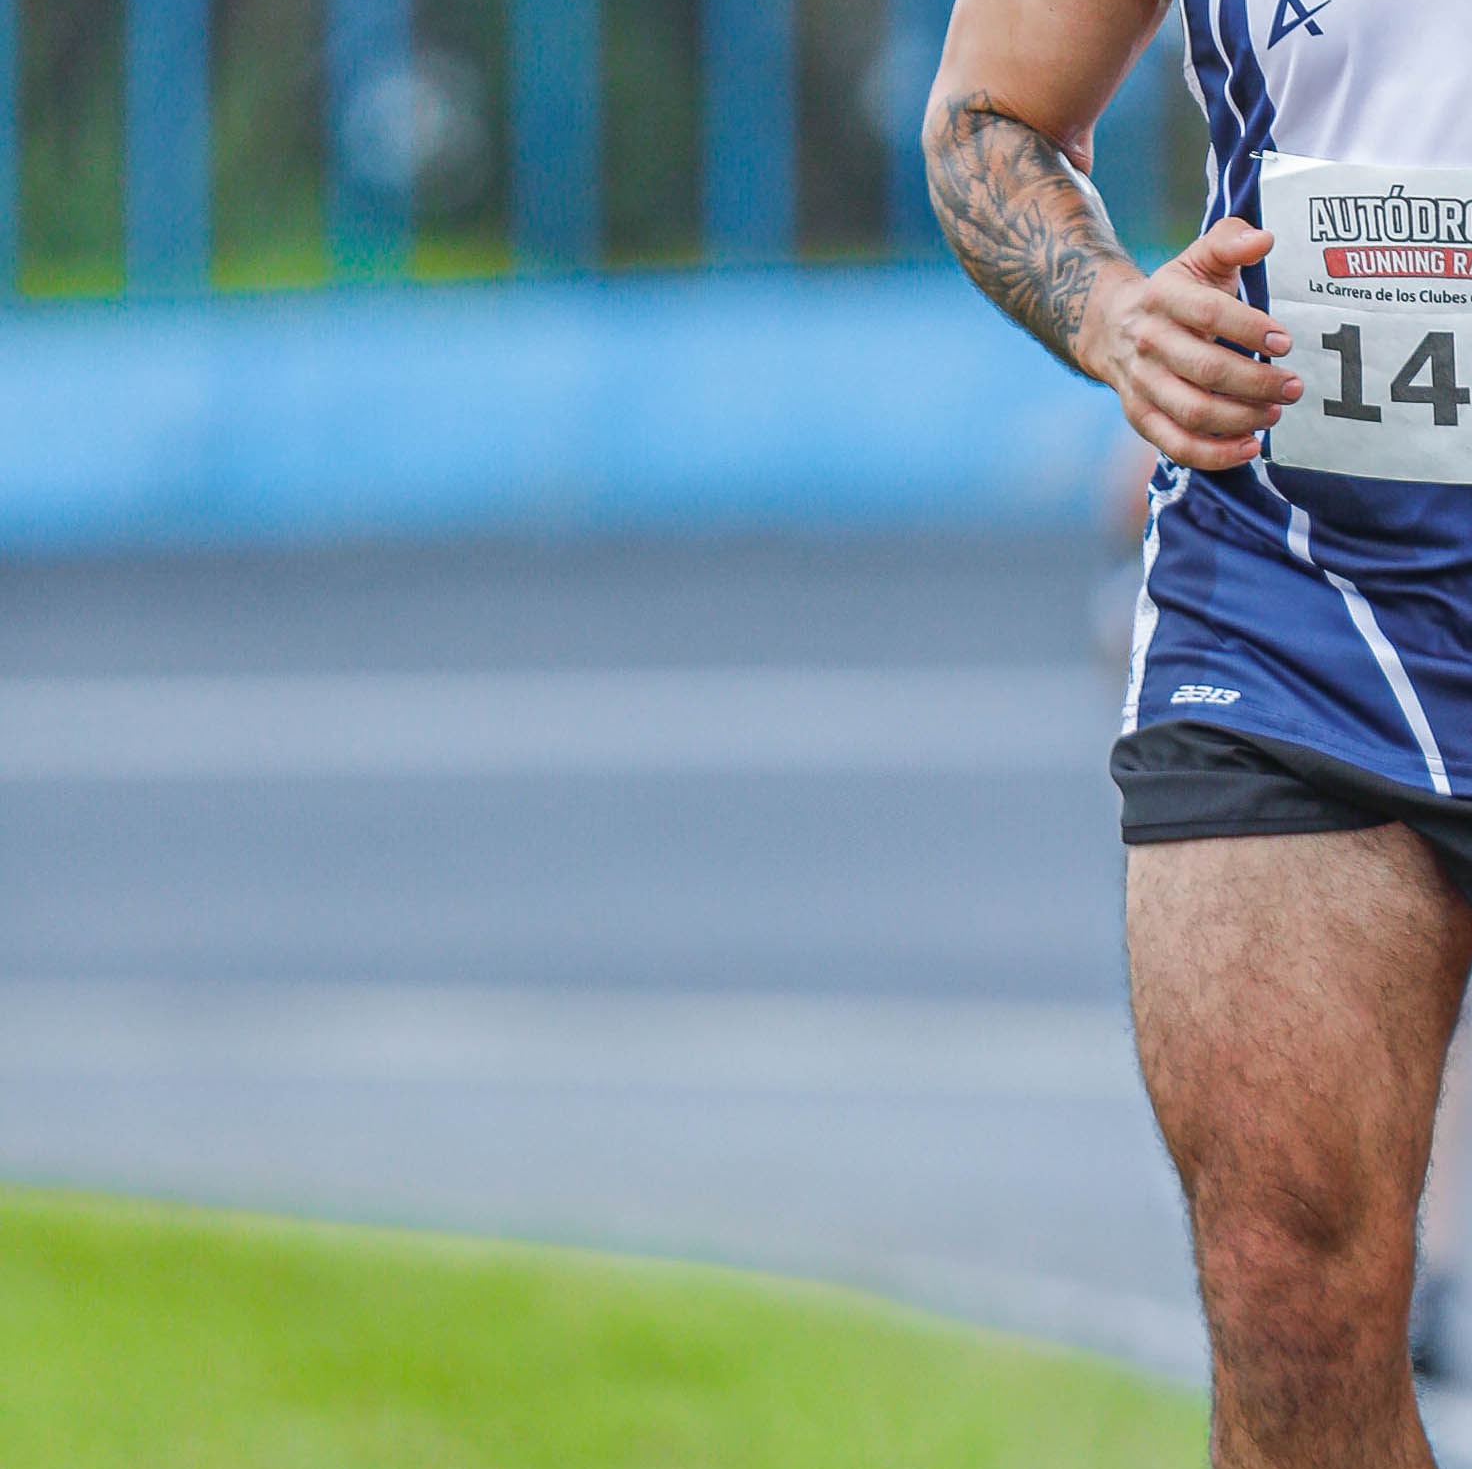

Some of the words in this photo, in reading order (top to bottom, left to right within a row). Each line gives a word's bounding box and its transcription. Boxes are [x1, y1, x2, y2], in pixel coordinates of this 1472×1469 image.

[1345, 249, 1446, 276] RUNNING
[1308, 279, 1324, 293] La
[1326, 282, 1372, 300] Carrera
[1375, 287, 1393, 301] de
[1396, 288, 1416, 302] los
[1419, 289, 1467, 304] Clubes
